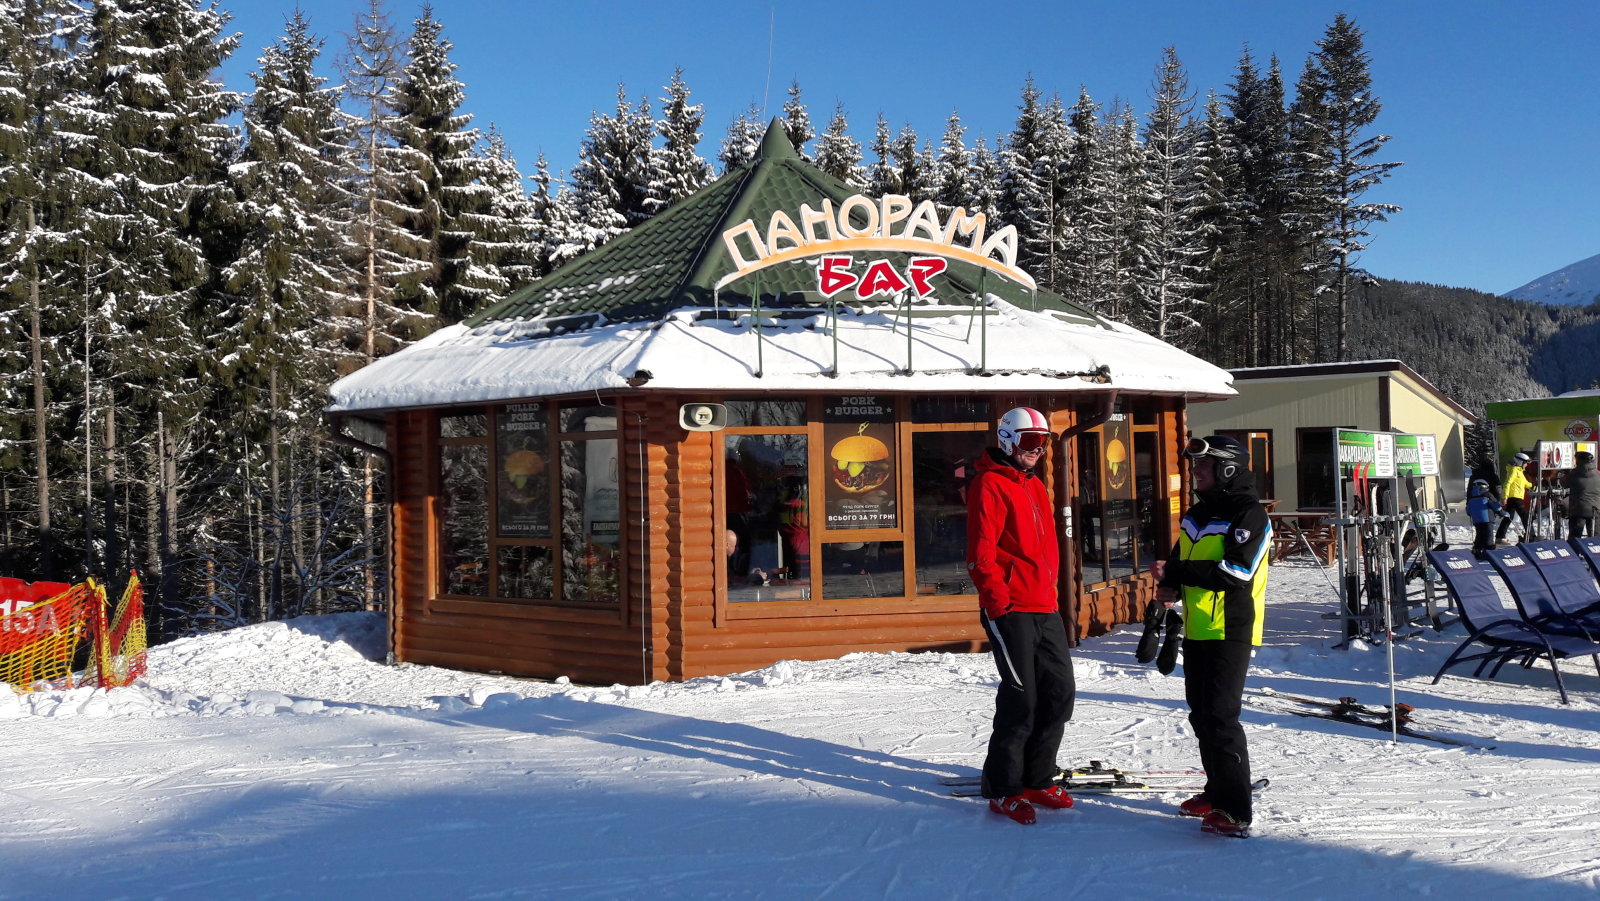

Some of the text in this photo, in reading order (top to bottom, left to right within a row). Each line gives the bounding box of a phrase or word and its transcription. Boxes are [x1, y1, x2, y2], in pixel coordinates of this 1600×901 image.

[723, 194, 1018, 270] ПАНОРАМА
[816, 255, 947, 300] БАР
[841, 397, 875, 405] PORK
[834, 406, 883, 415] BURGER
[511, 412, 536, 421] PORK
[506, 421, 540, 431] BURGER
